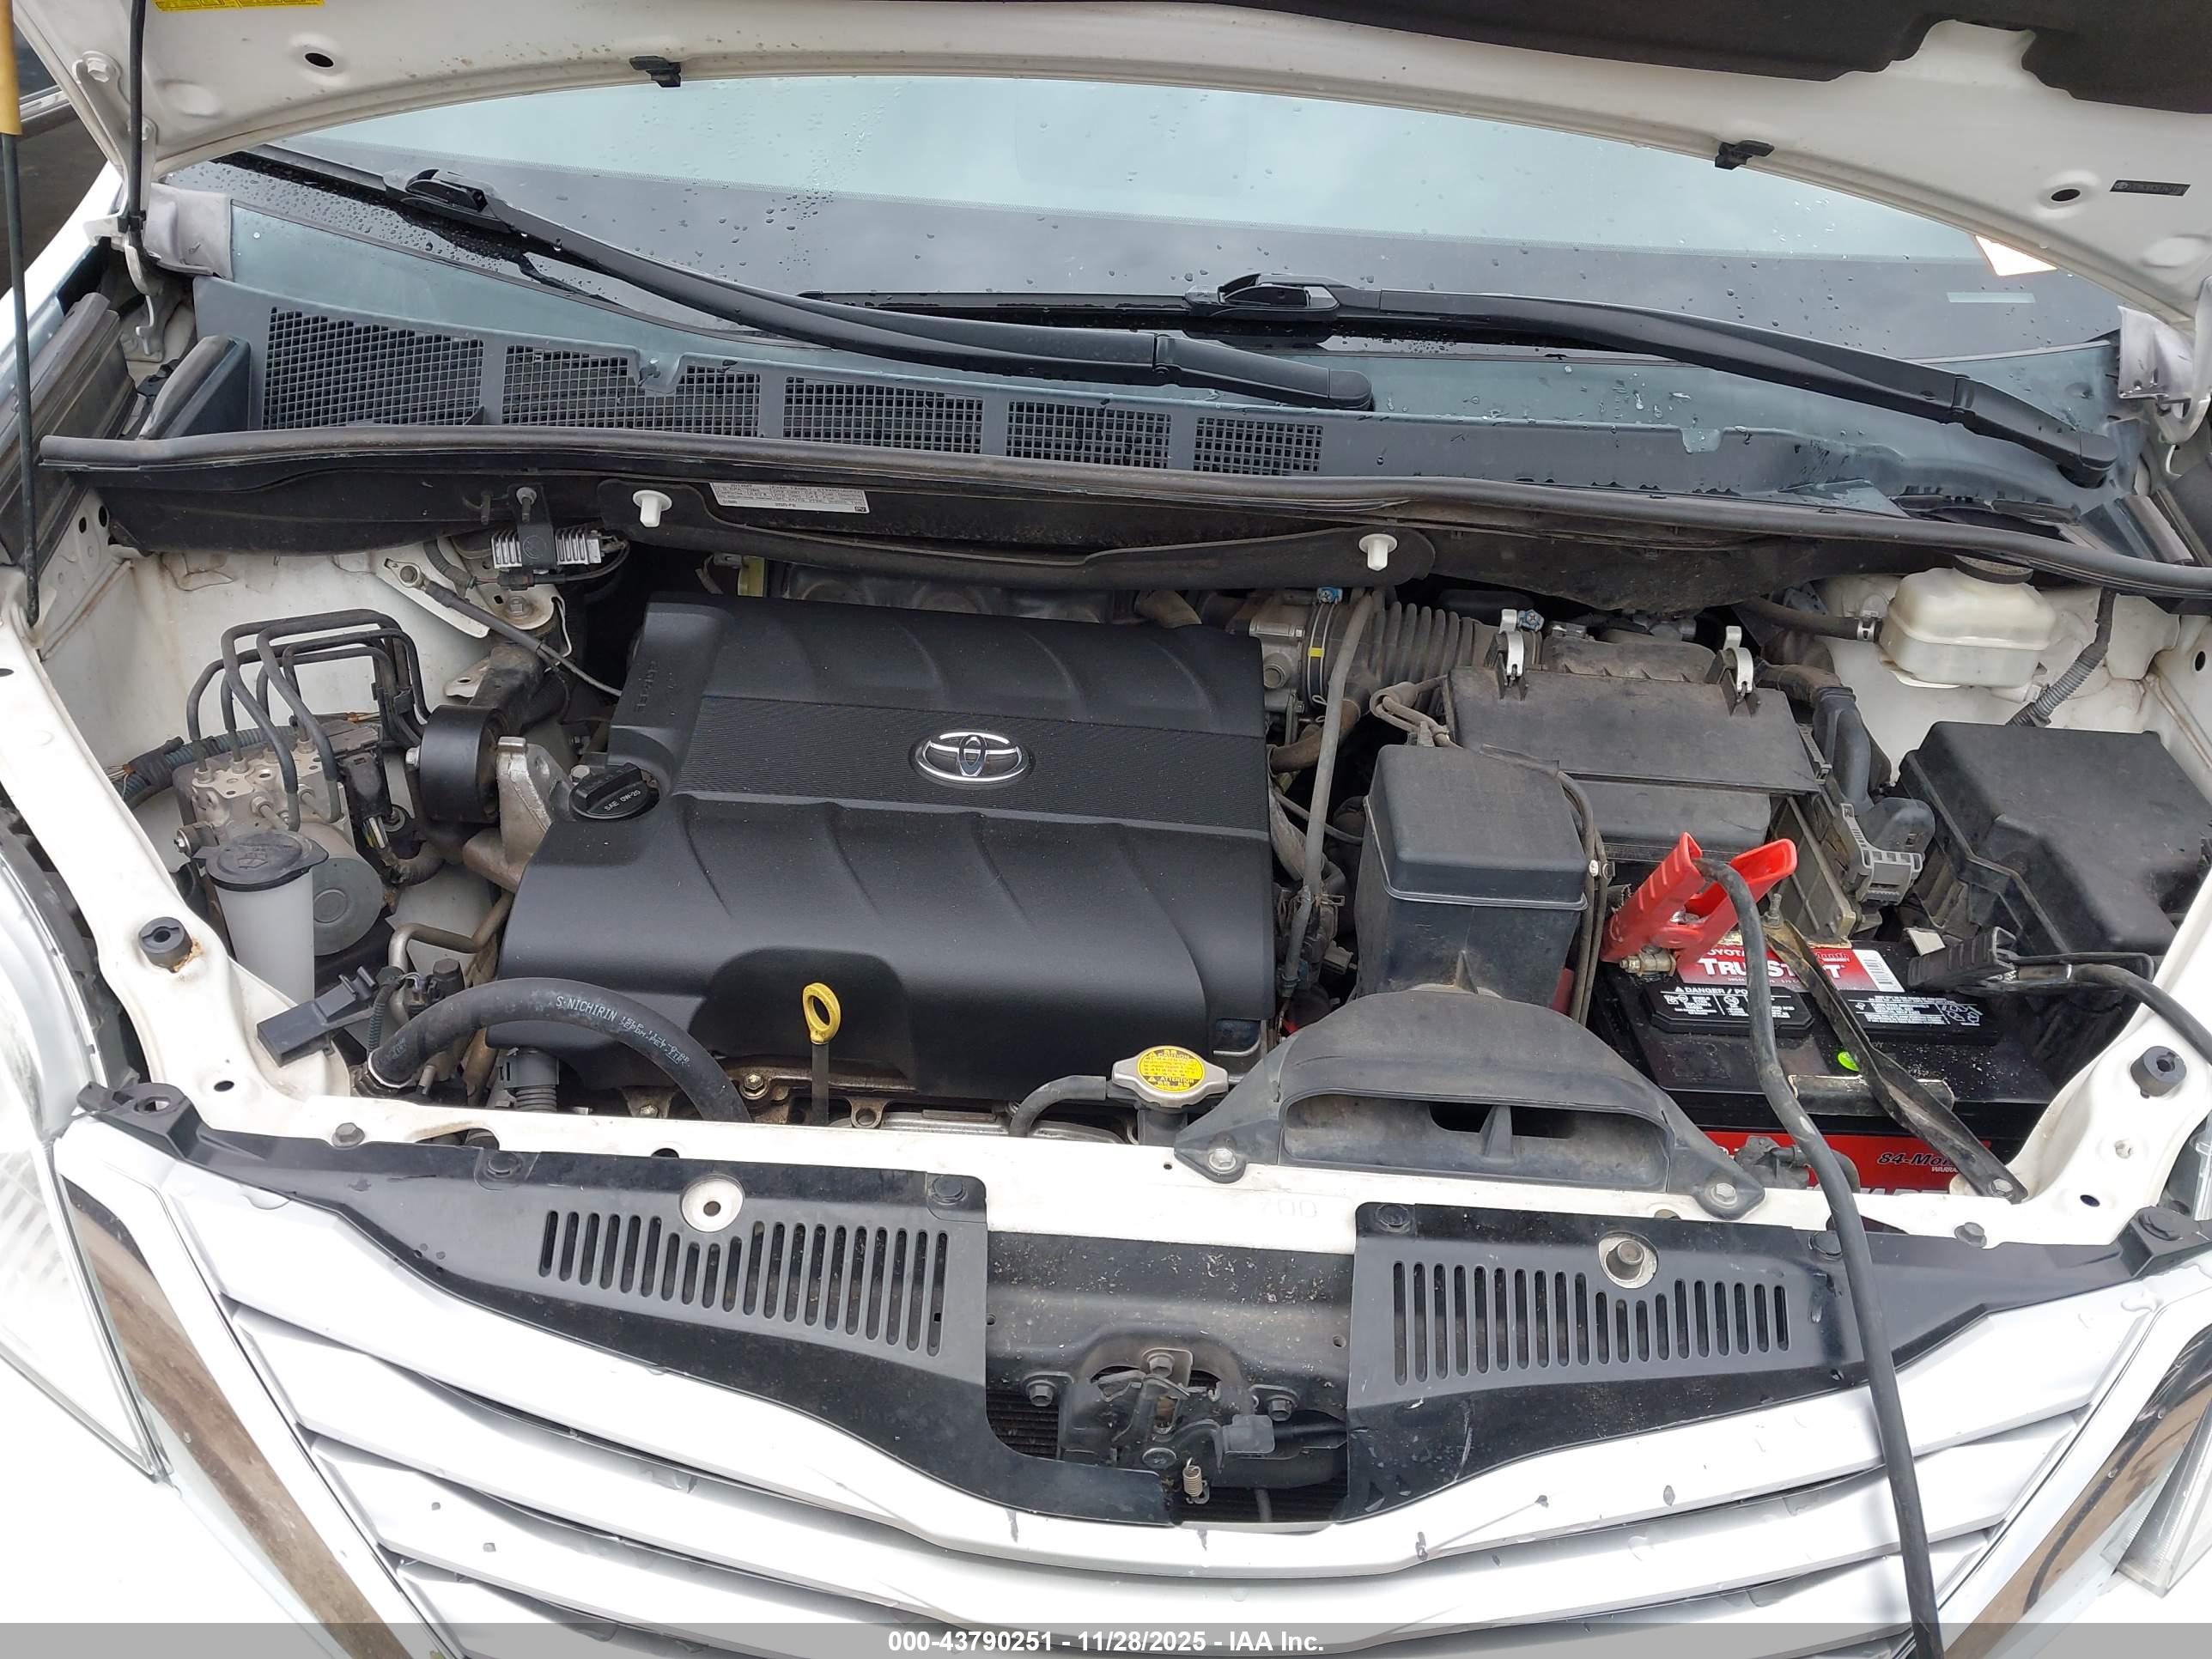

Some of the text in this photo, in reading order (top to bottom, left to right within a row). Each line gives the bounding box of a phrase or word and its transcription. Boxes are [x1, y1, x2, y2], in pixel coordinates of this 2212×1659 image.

[604, 789, 642, 811] SAE 0W-20
[1706, 948, 1745, 957] OYOT
